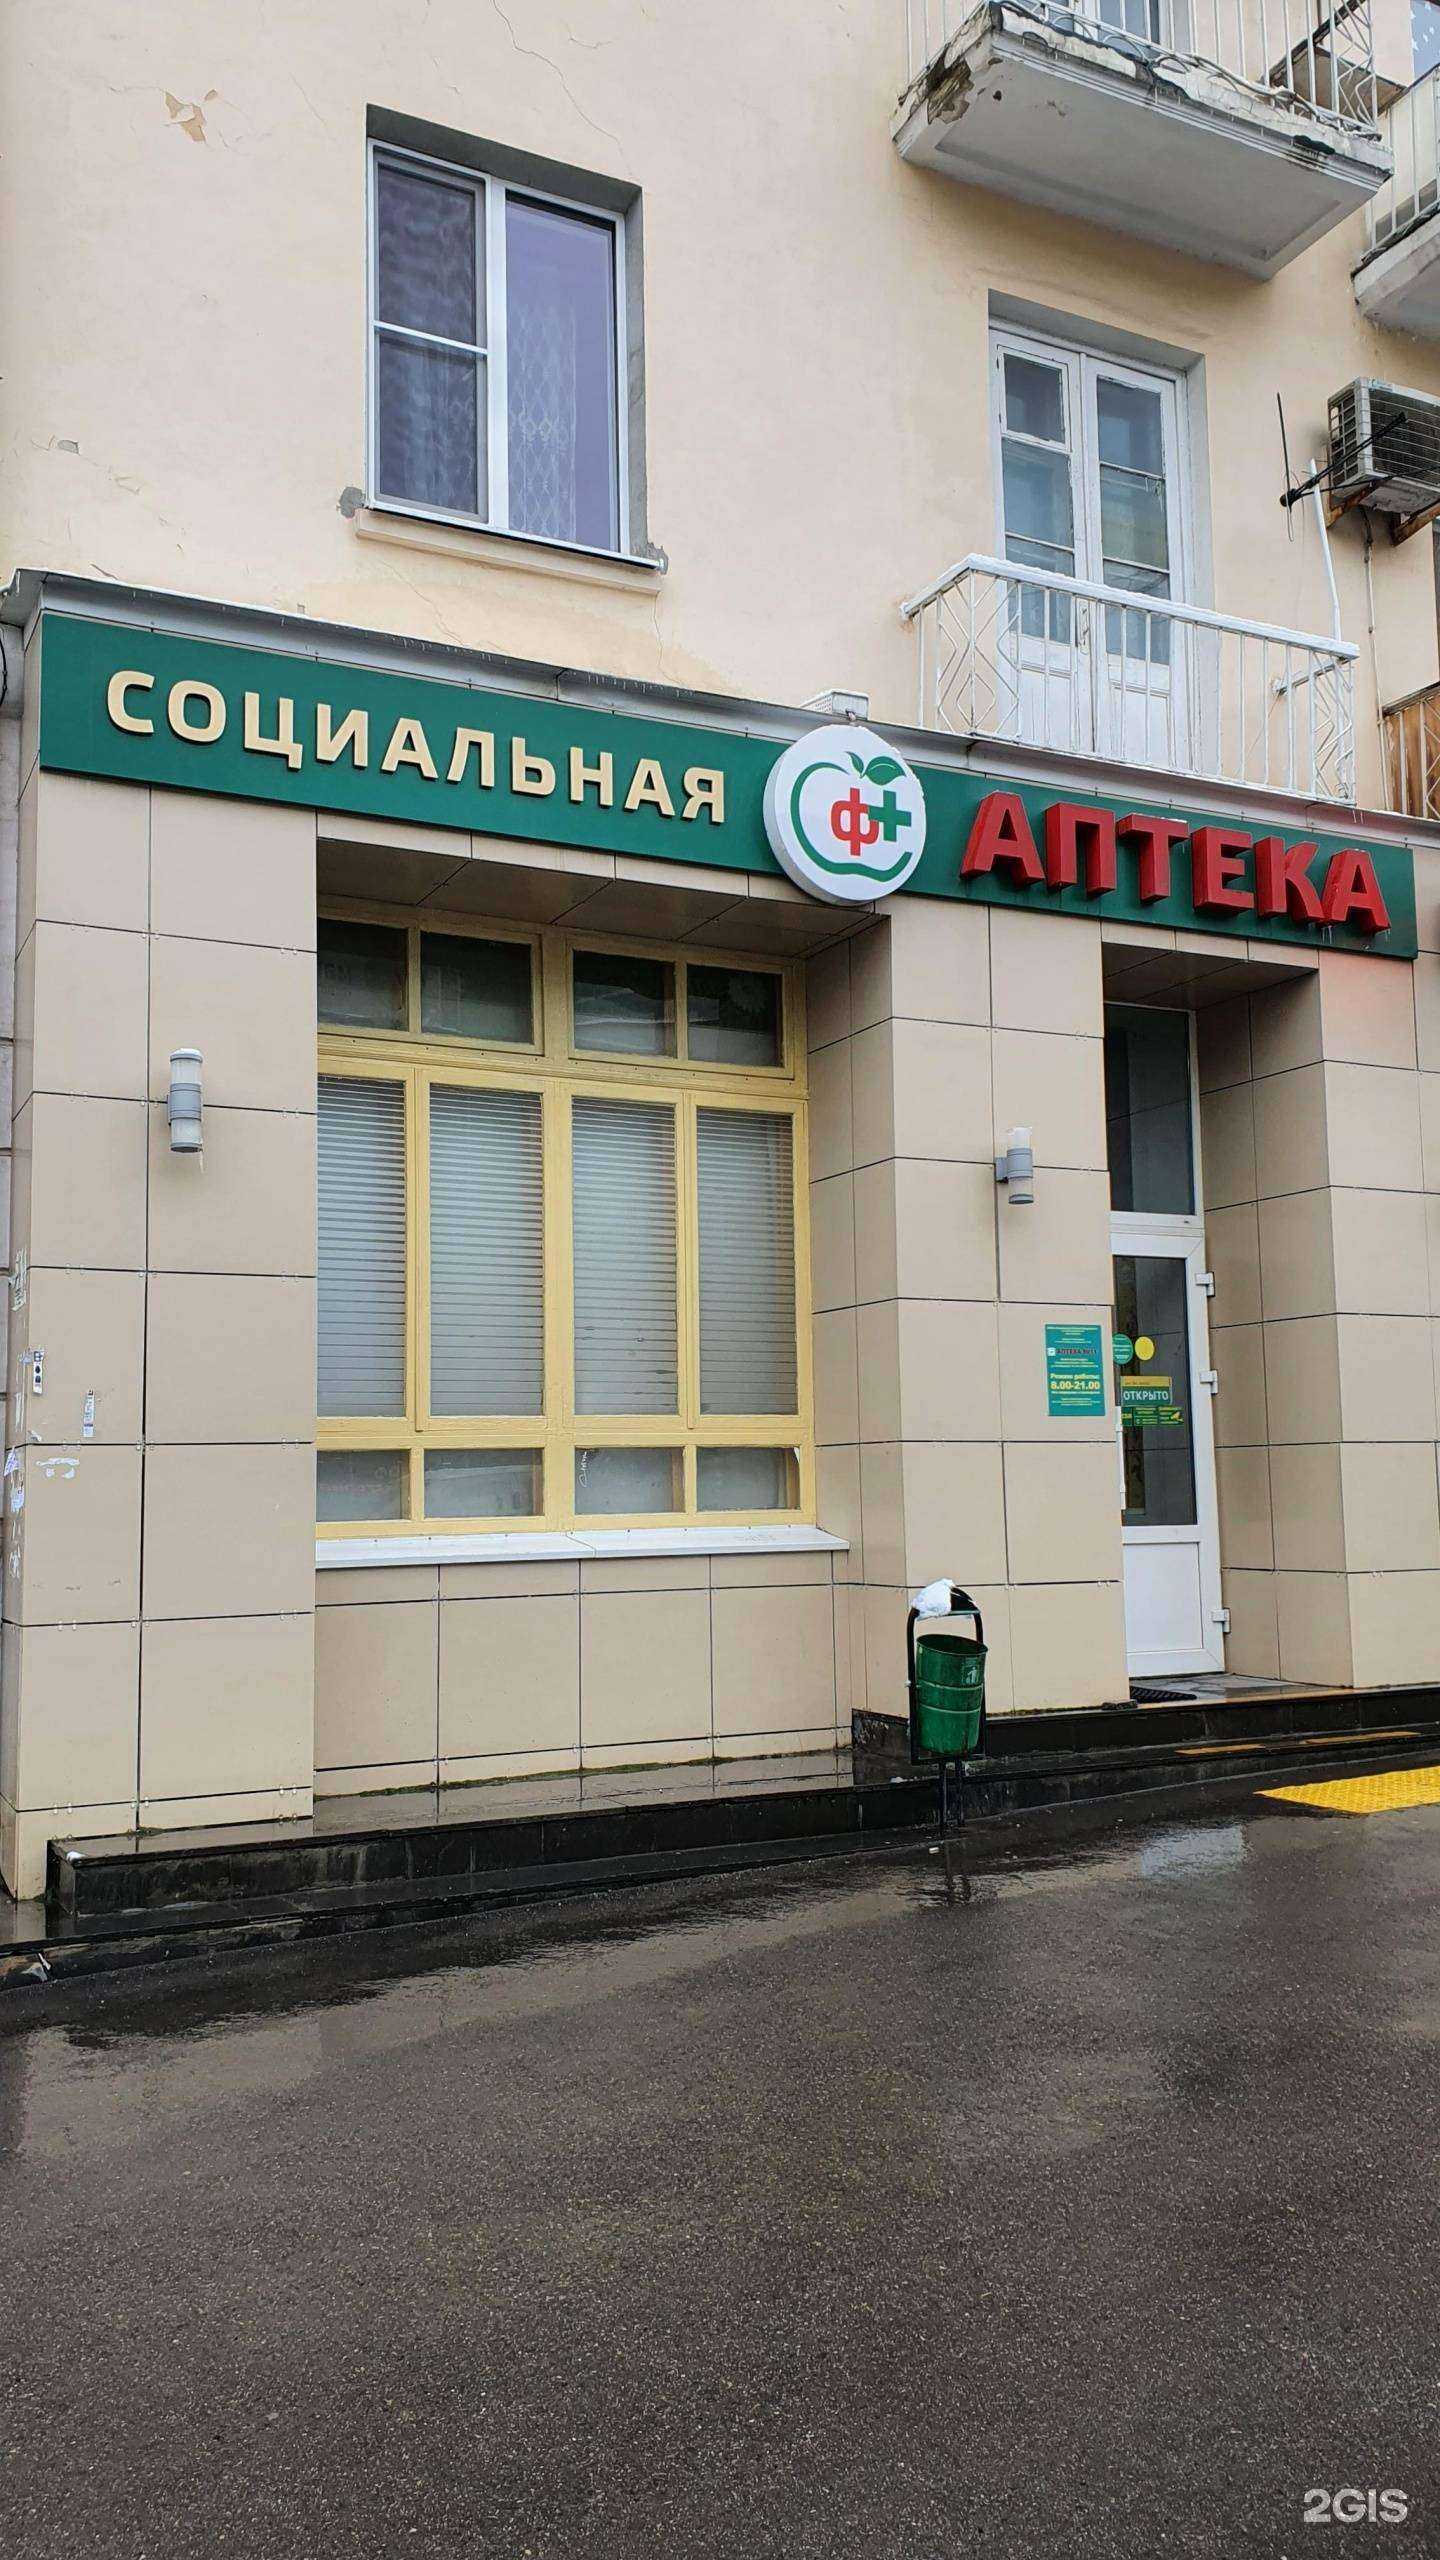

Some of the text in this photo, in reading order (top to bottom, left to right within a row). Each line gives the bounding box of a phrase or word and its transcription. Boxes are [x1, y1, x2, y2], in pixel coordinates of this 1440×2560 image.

[106, 670, 726, 824] СОЦИАЛЬНАЯ
[959, 790, 1392, 934] АПТЕКА
[1123, 1390, 1169, 1400] ОТКРЫТО
